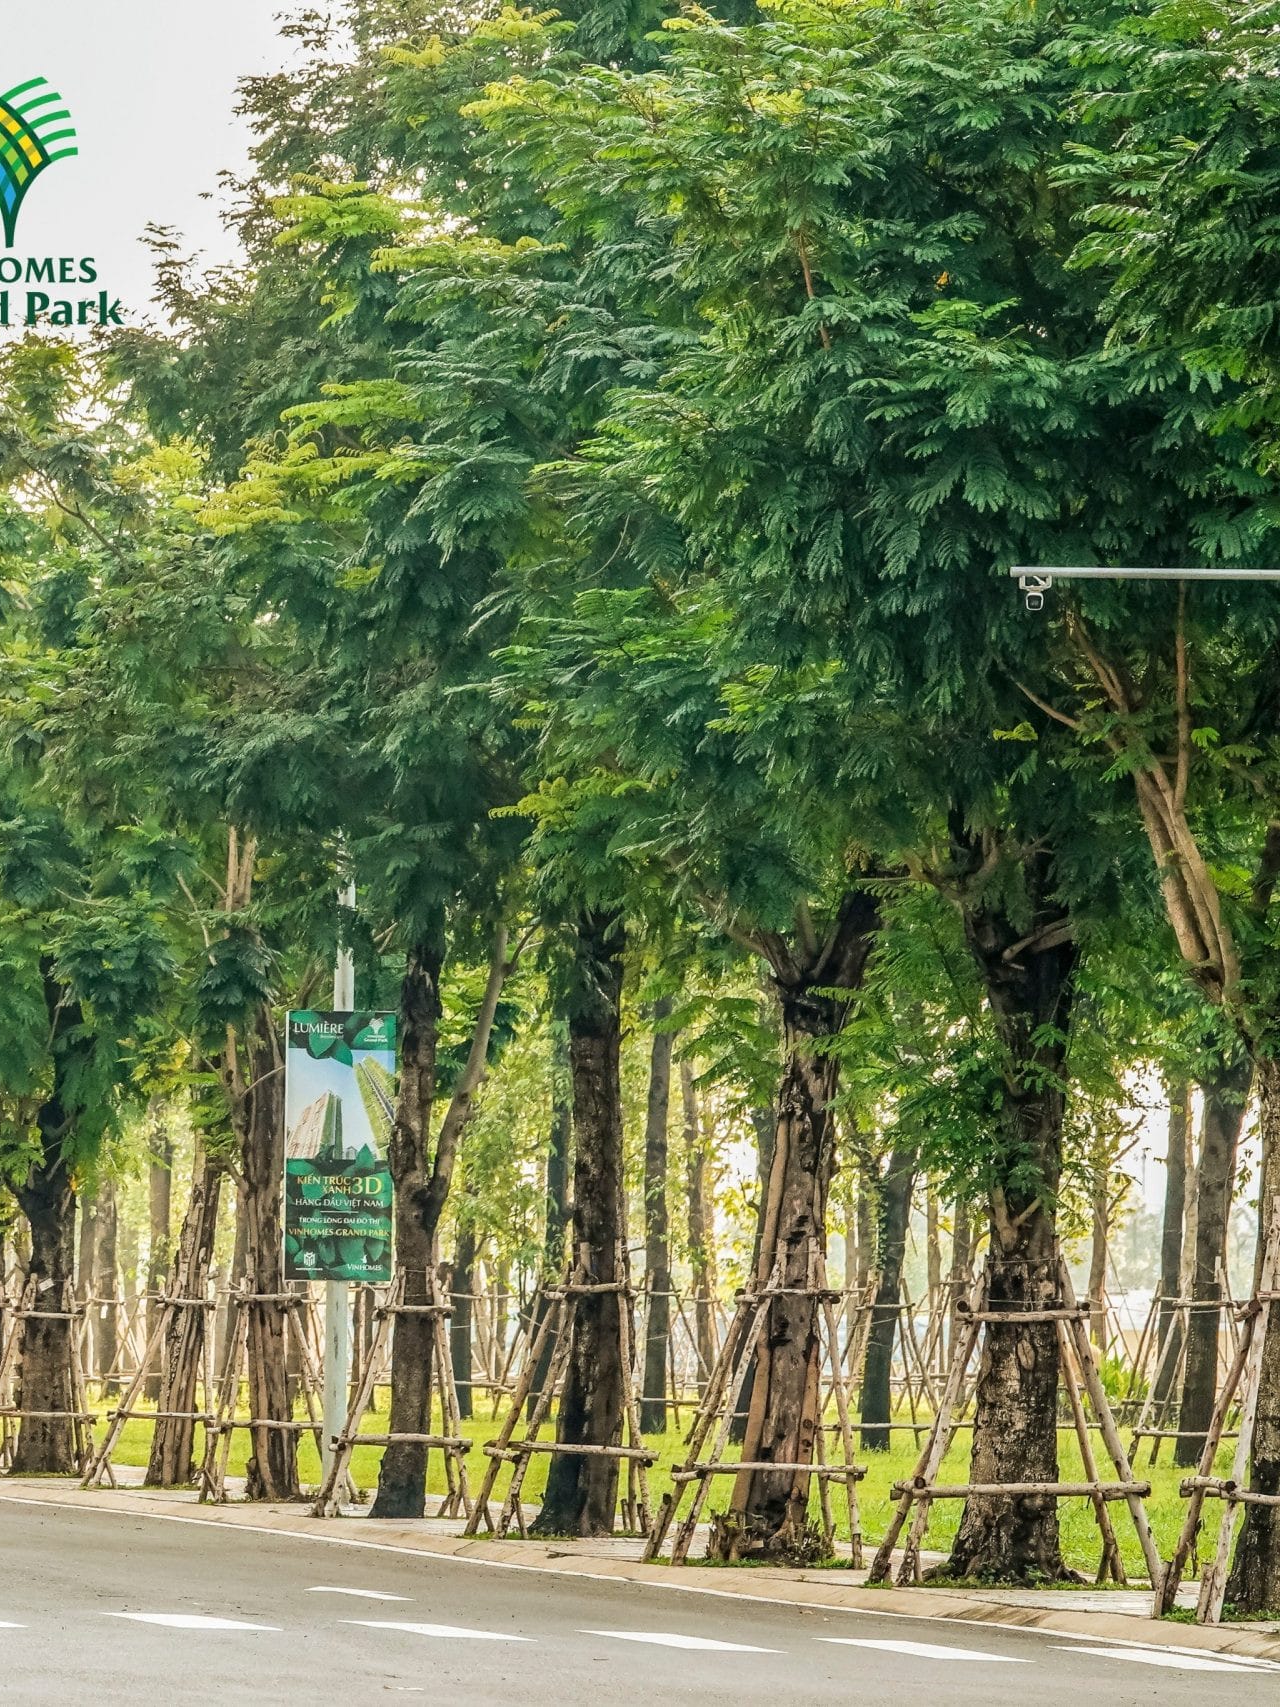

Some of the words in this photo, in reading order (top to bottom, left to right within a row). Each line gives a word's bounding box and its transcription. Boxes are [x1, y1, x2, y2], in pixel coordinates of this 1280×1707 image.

[294, 1021, 345, 1034] LUMIÈRE
[323, 1185, 351, 1194] XANH
[352, 1176, 383, 1195] 3D
[288, 1228, 334, 1236] VINHOMES
[335, 1228, 367, 1237] GRAND
[368, 1229, 390, 1237] PARK
